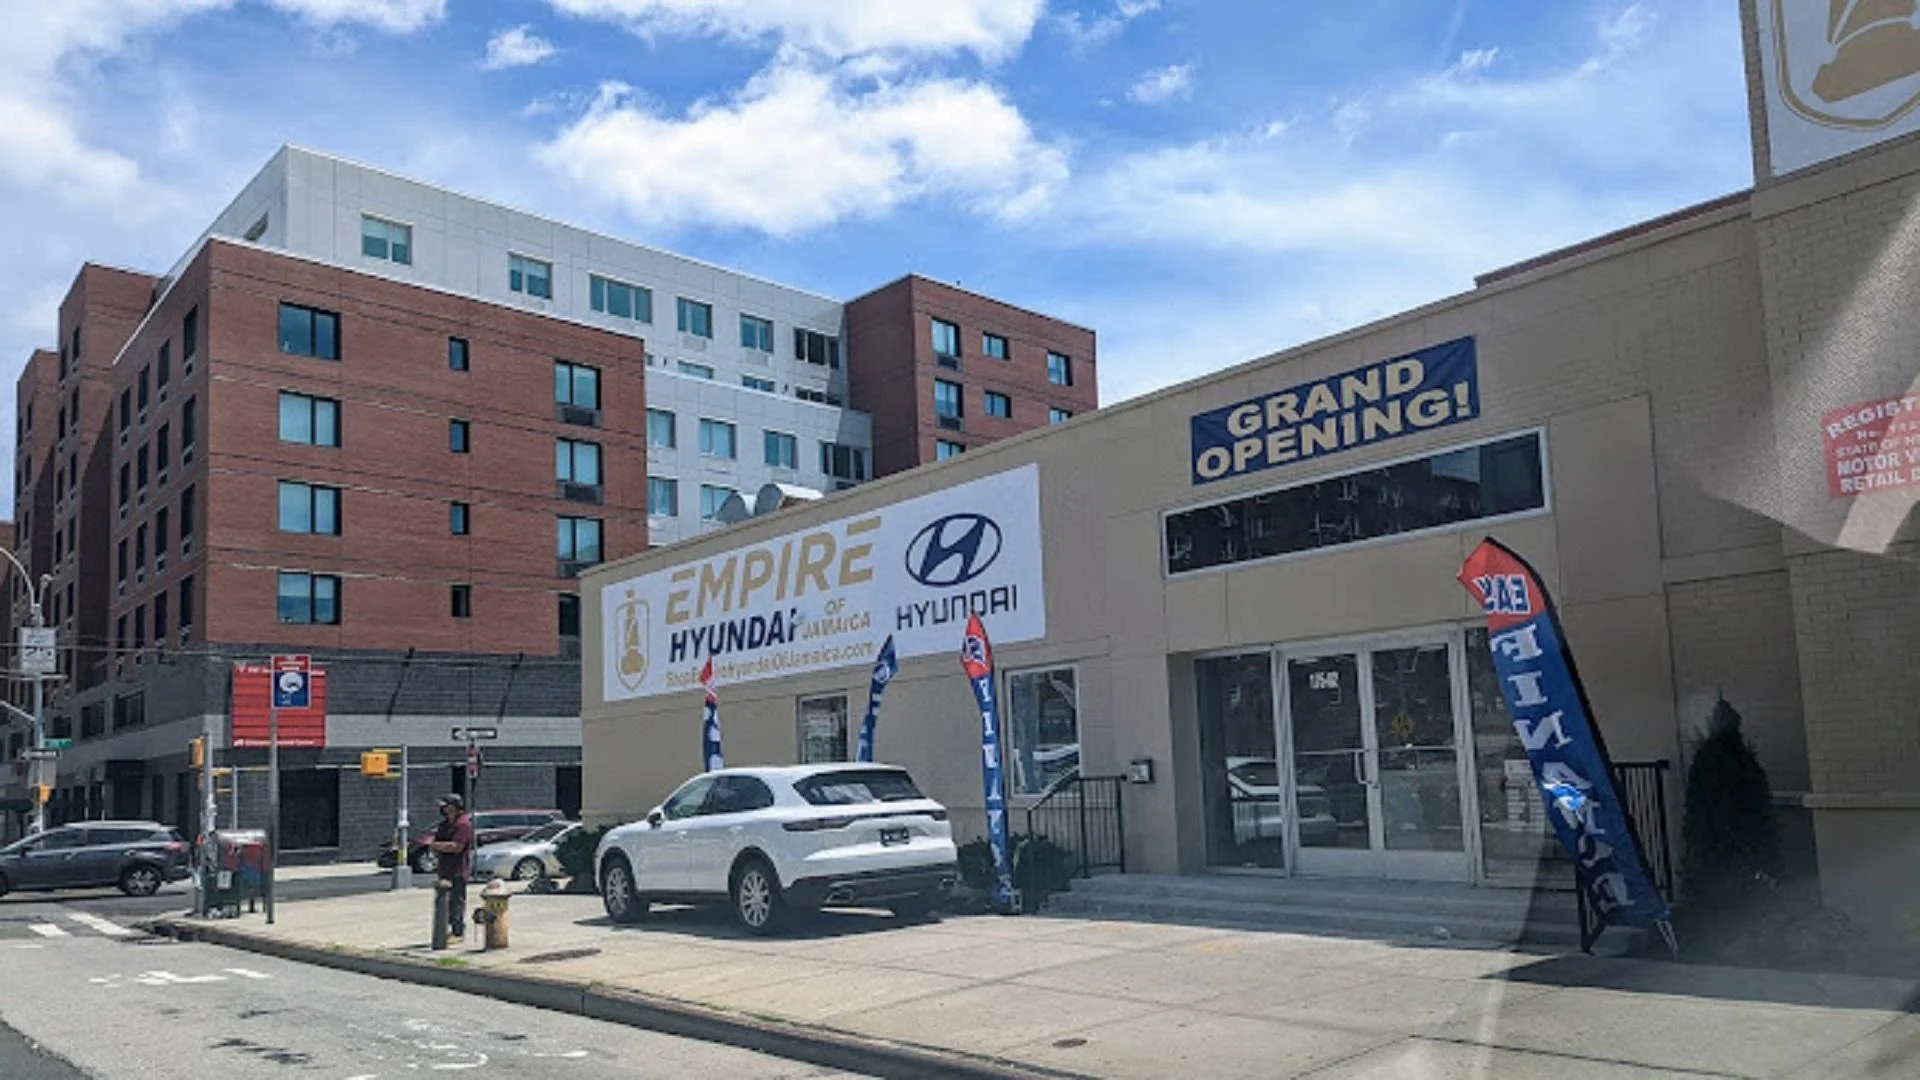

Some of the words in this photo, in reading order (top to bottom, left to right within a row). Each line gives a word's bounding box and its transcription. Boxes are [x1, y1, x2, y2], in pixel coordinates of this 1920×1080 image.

[1227, 359, 1425, 438] GRAND
[1196, 381, 1471, 478] OPENING!
[1837, 452, 1900, 477] MOTOR
[1841, 471, 1905, 493] RETAIL
[665, 516, 882, 625] EMPIRE
[802, 611, 871, 639] JAMAICA
[824, 598, 845, 616] OF
[897, 584, 1017, 631] HYUNDAI
[669, 608, 798, 663] HYUNDAI
